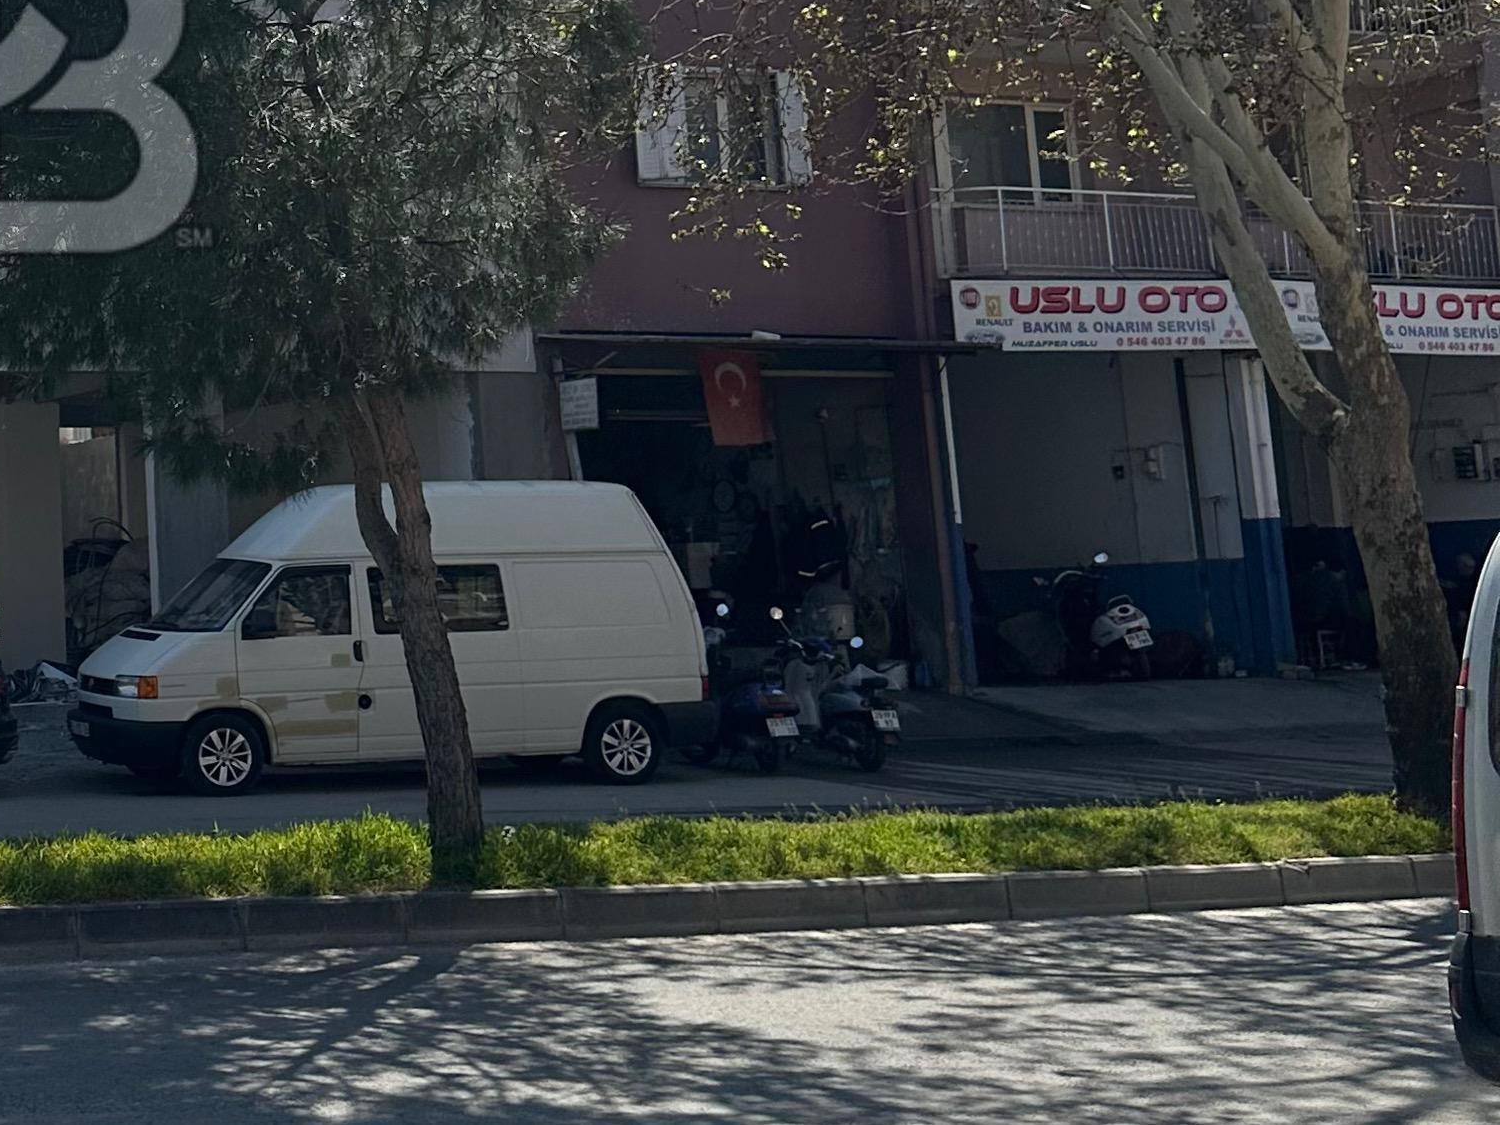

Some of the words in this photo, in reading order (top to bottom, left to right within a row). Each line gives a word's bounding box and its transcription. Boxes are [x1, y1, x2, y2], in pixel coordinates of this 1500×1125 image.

[1009, 286, 1126, 315] USLU
[1138, 286, 1227, 313] OTO
[1373, 291, 1426, 319] LU
[1023, 321, 1072, 334] BAKIM
[1077, 321, 1088, 333] &
[1094, 321, 1152, 334] ONARIM
[1385, 324, 1394, 336] &
[1398, 325, 1449, 337] ONARIM
[1453, 324, 1500, 339] SERVİS
[1011, 340, 1068, 348] MUZAFFER
[1071, 340, 1098, 348] USLU
[1116, 337, 1123, 346] 0
[1127, 337, 1147, 346] 546
[1151, 336, 1172, 346] 403
[1175, 336, 1188, 346] 47
